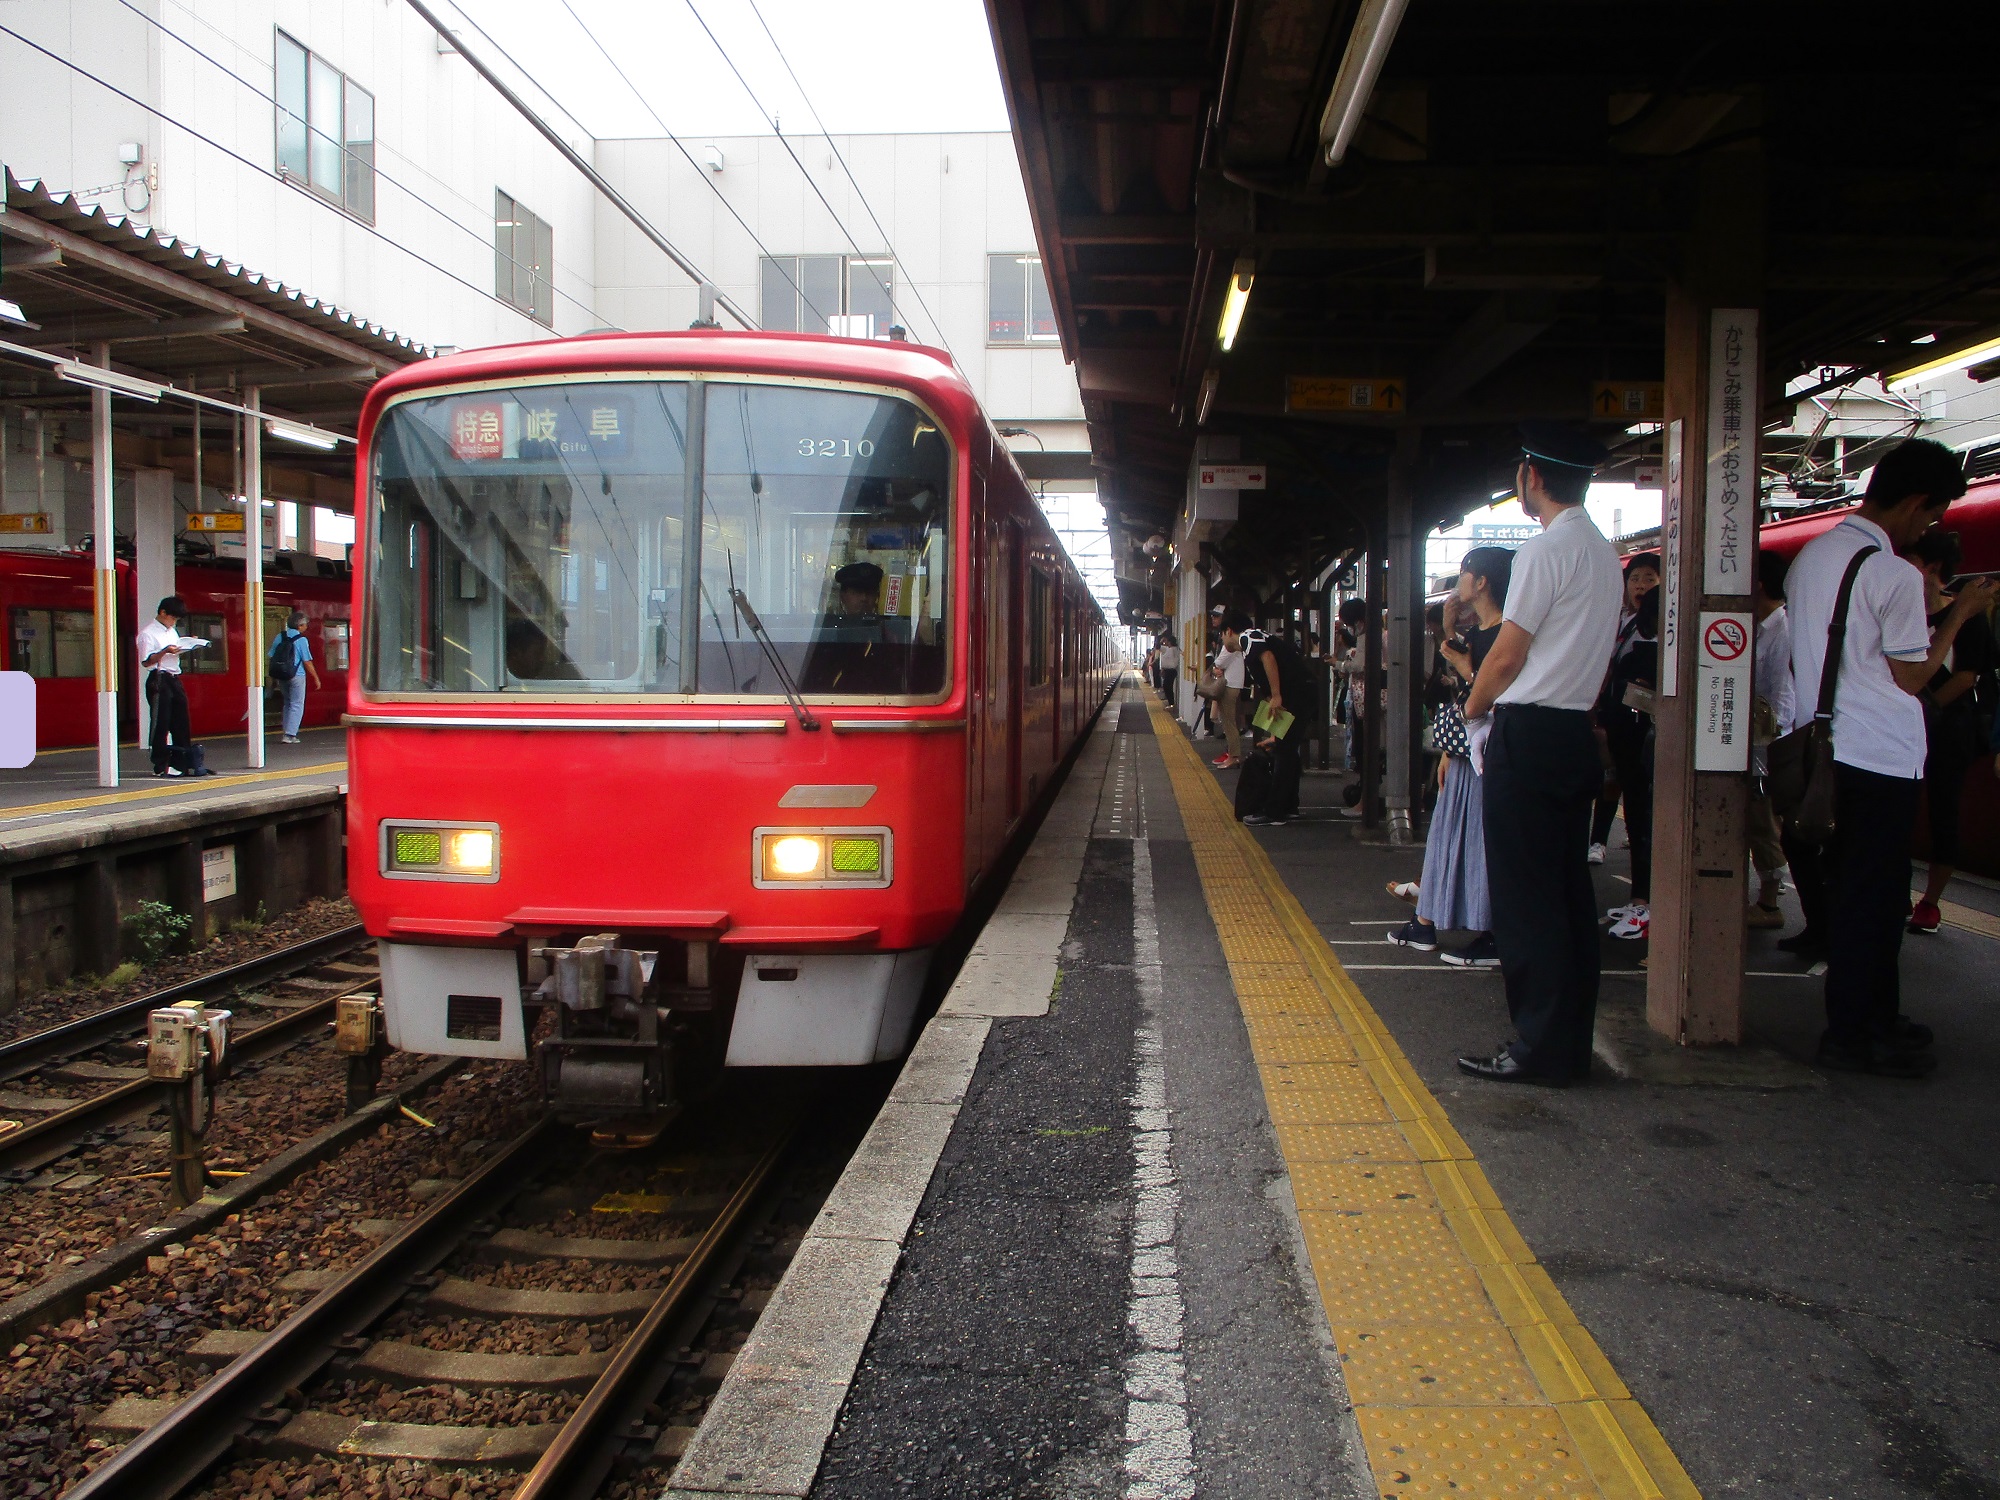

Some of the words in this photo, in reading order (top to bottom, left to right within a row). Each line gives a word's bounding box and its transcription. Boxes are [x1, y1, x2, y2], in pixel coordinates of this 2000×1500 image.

[1291, 382, 1346, 396] エレベーター
[457, 410, 500, 443] 特急
[527, 407, 621, 442] 岐阜
[560, 442, 588, 453] Gifu
[798, 438, 875, 458] 3210
[1720, 325, 1743, 574] かけこみ乗車はおやめください
[1667, 461, 1681, 647] しんあんじょう
[1340, 569, 1355, 587] 3
[1711, 676, 1720, 690] No
[1707, 694, 1719, 733] Smoking
[1721, 677, 1735, 745] 終日構内禁煙
